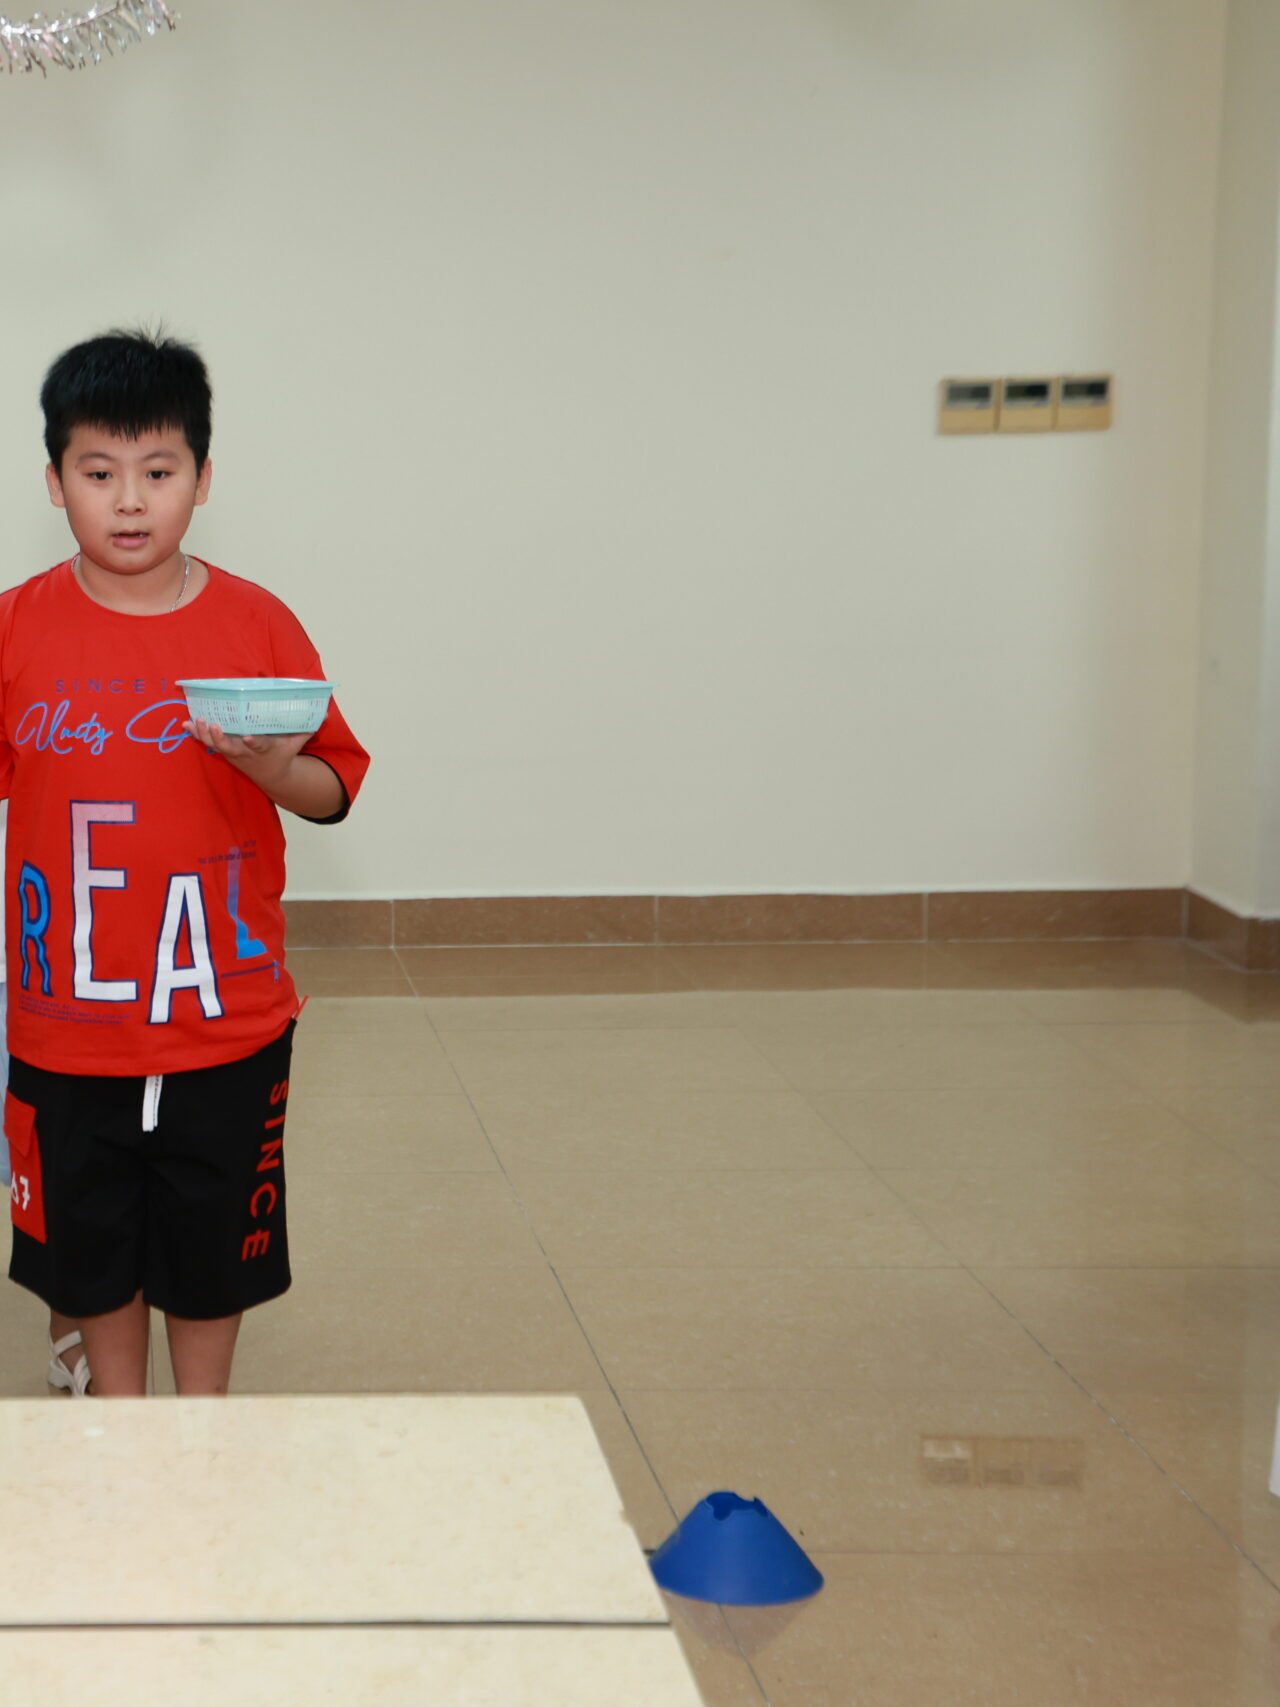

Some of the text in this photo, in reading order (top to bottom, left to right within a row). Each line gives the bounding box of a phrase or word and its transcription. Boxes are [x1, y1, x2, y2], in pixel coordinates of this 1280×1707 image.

[55, 679, 145, 693] SINCE
[18, 800, 267, 1025] REAL
[241, 1079, 289, 1261] SINCE
